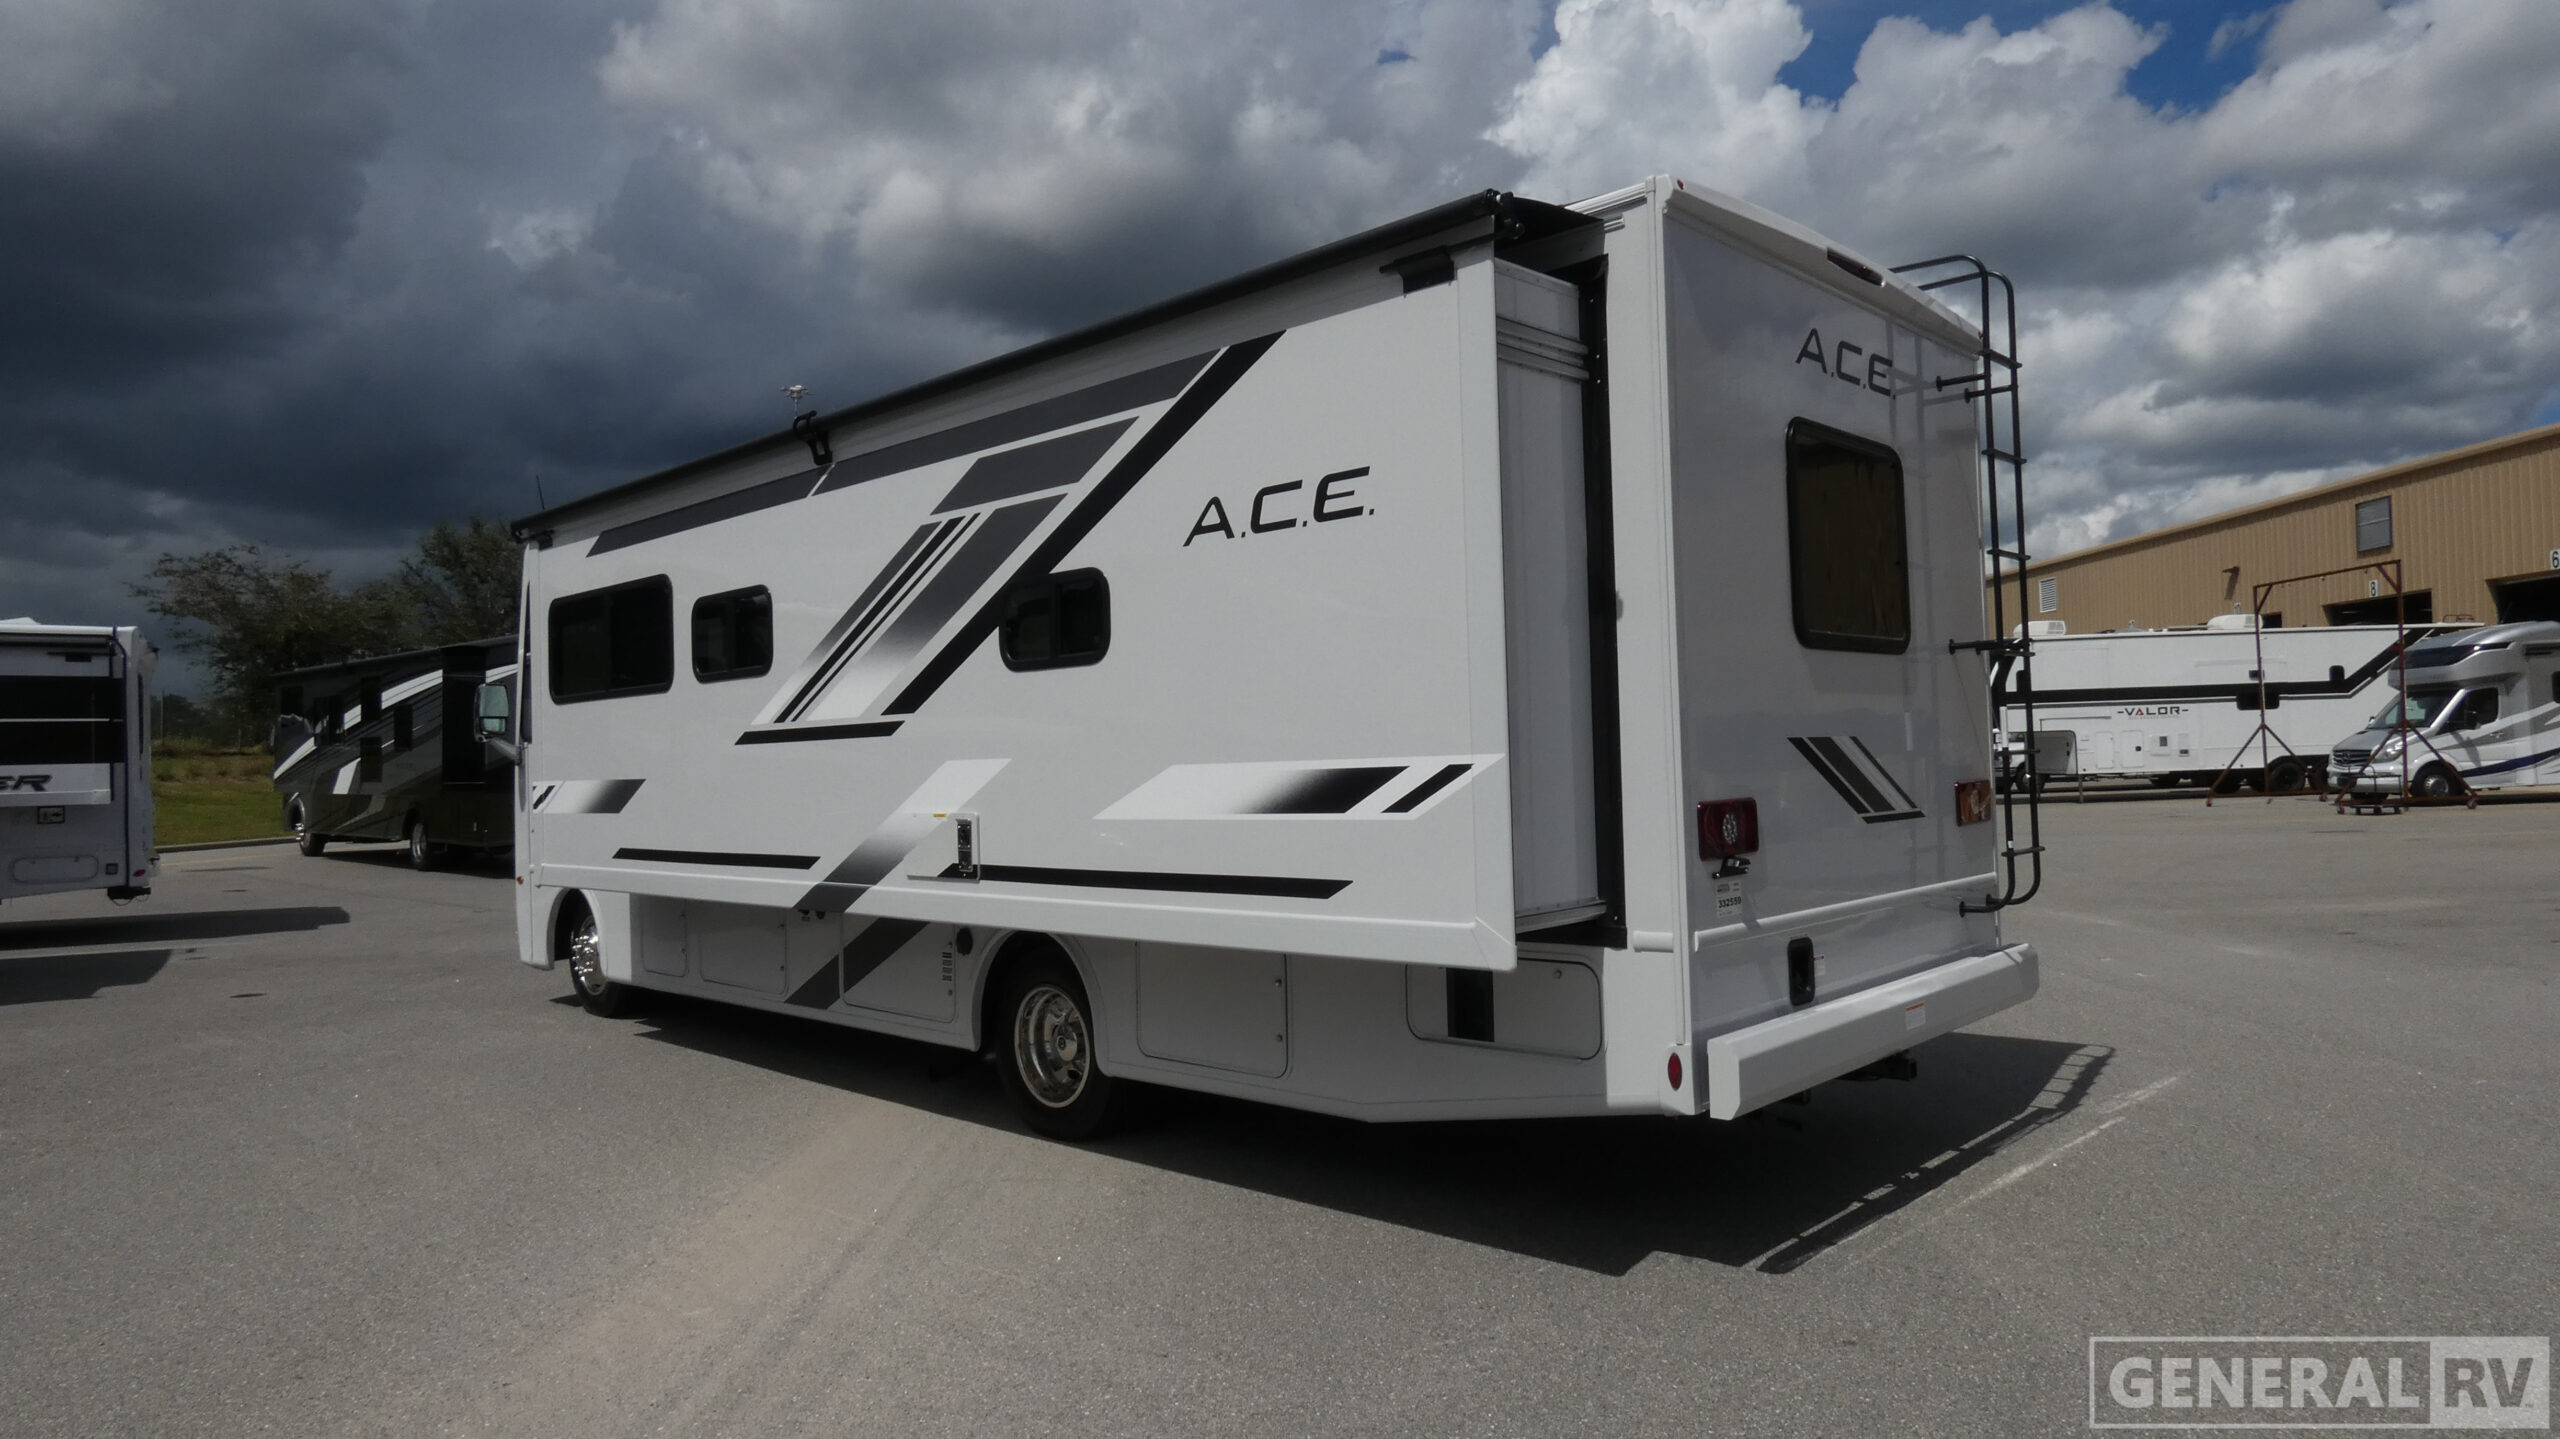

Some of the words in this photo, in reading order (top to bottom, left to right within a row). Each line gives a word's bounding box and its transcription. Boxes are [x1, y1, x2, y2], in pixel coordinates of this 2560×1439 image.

[1795, 328, 1896, 400] A.C.E.
[1182, 465, 1375, 547] A.C.E.
[2551, 550, 2560, 569] 6
